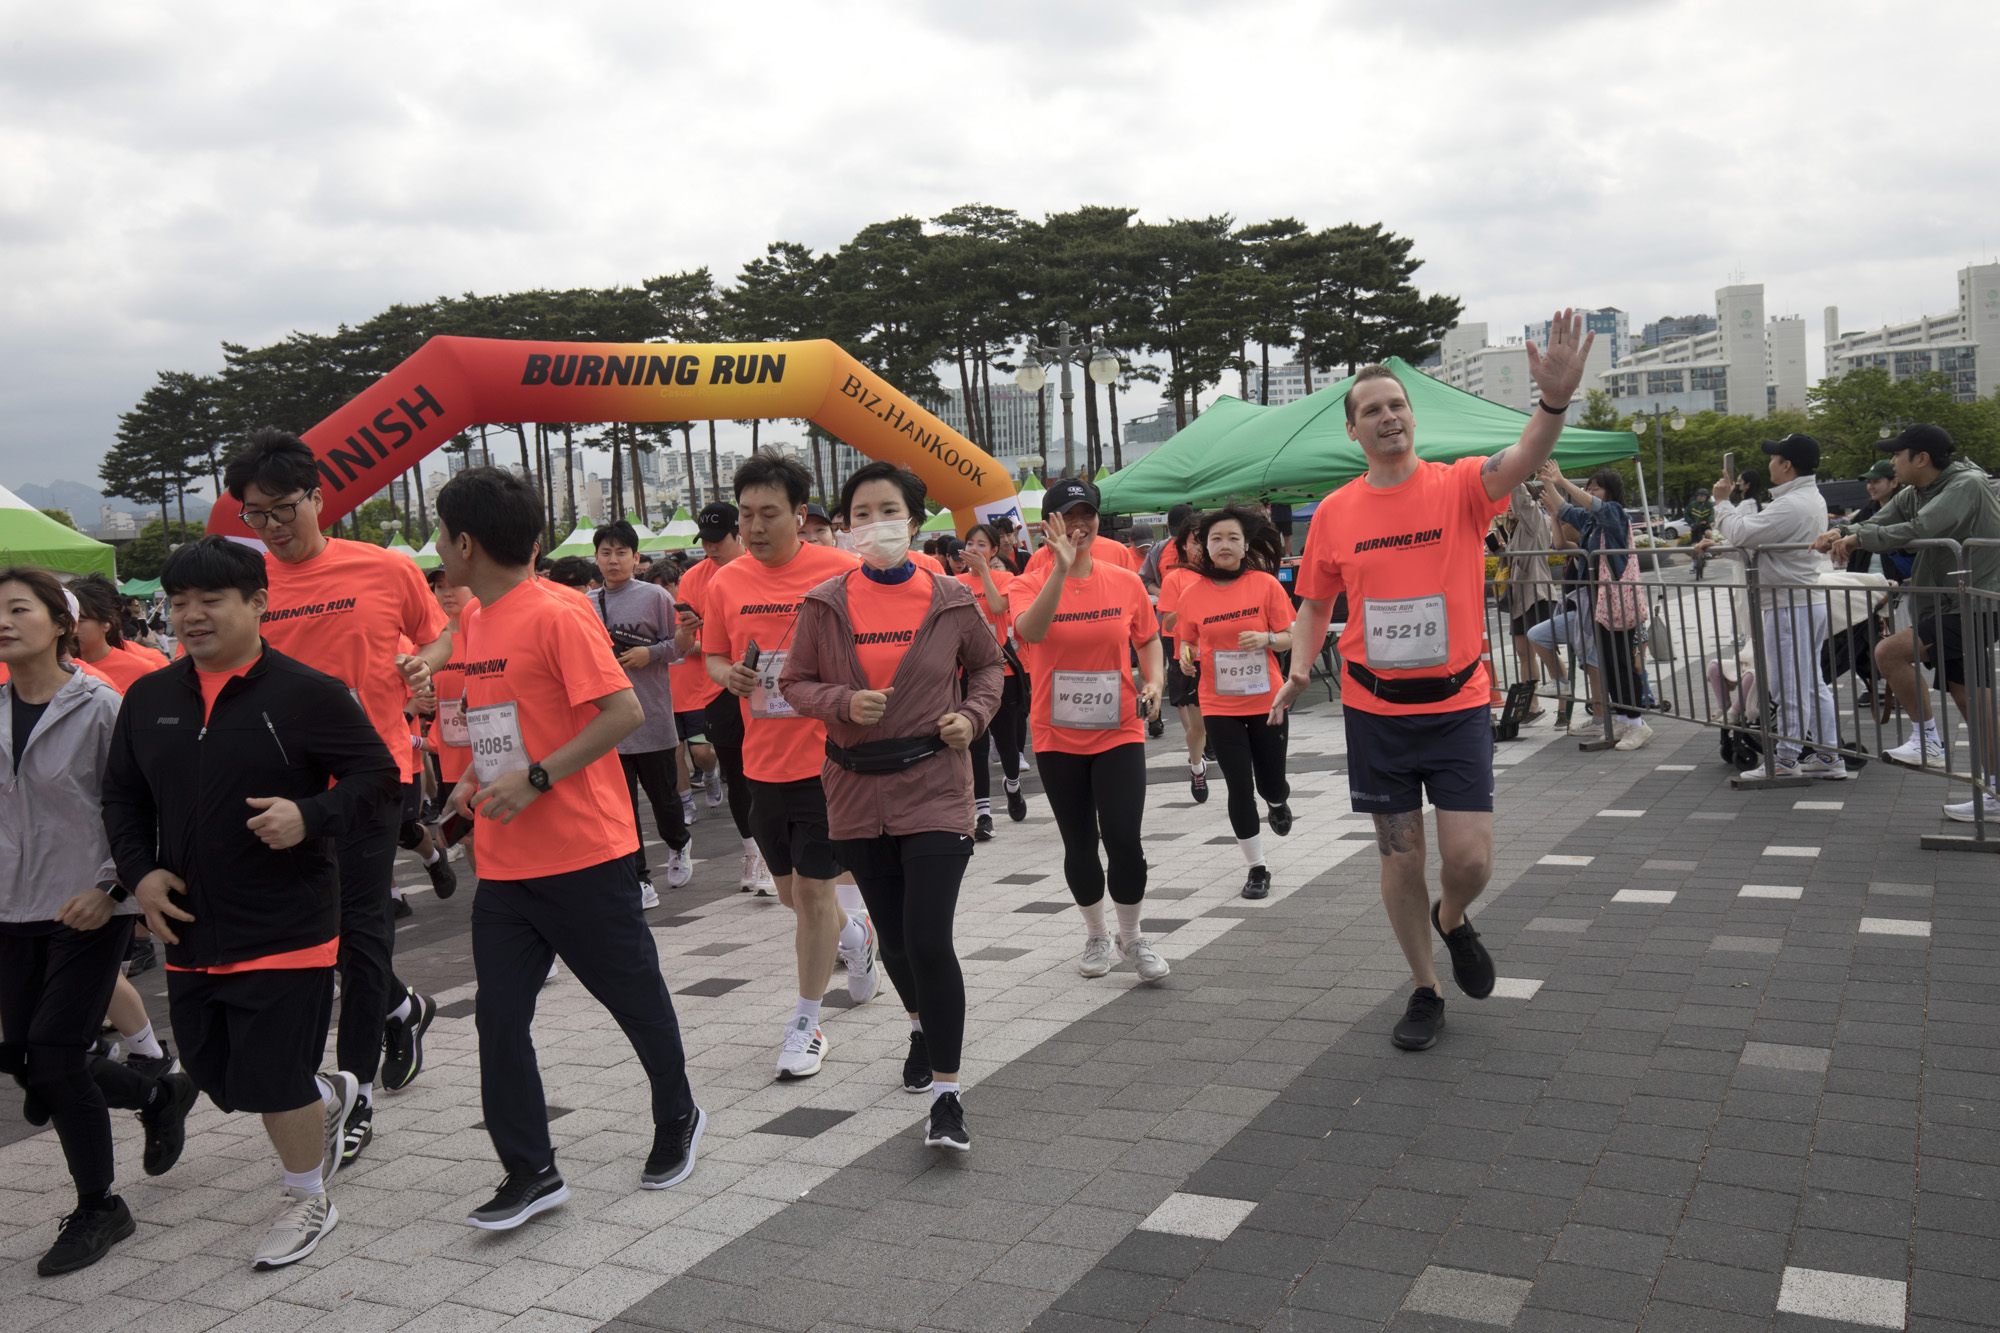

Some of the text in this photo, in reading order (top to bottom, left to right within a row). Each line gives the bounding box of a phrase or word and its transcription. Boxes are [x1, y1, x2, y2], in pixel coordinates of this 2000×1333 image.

[520, 354, 786, 386] BURNING RUN
[660, 387, 696, 398] Casual
[316, 384, 445, 492] INISH
[1354, 528, 1443, 554] BURNING RUN
[260, 597, 356, 623] BURNING RUN
[740, 603, 791, 615] BURNING
[1052, 610, 1100, 623] BURNING
[1100, 607, 1122, 618] RUN
[1203, 611, 1241, 625] BURNING
[1241, 606, 1260, 617] RUN
[1369, 604, 1397, 612] BURNING
[853, 630, 912, 646] BURNING
[1373, 621, 1437, 639] M 5218
[488, 659, 508, 673] RUN
[1230, 664, 1262, 677] 6139
[1059, 692, 1113, 705] W 6210
[500, 711, 512, 719] 5km
[473, 735, 513, 756] M 5085
